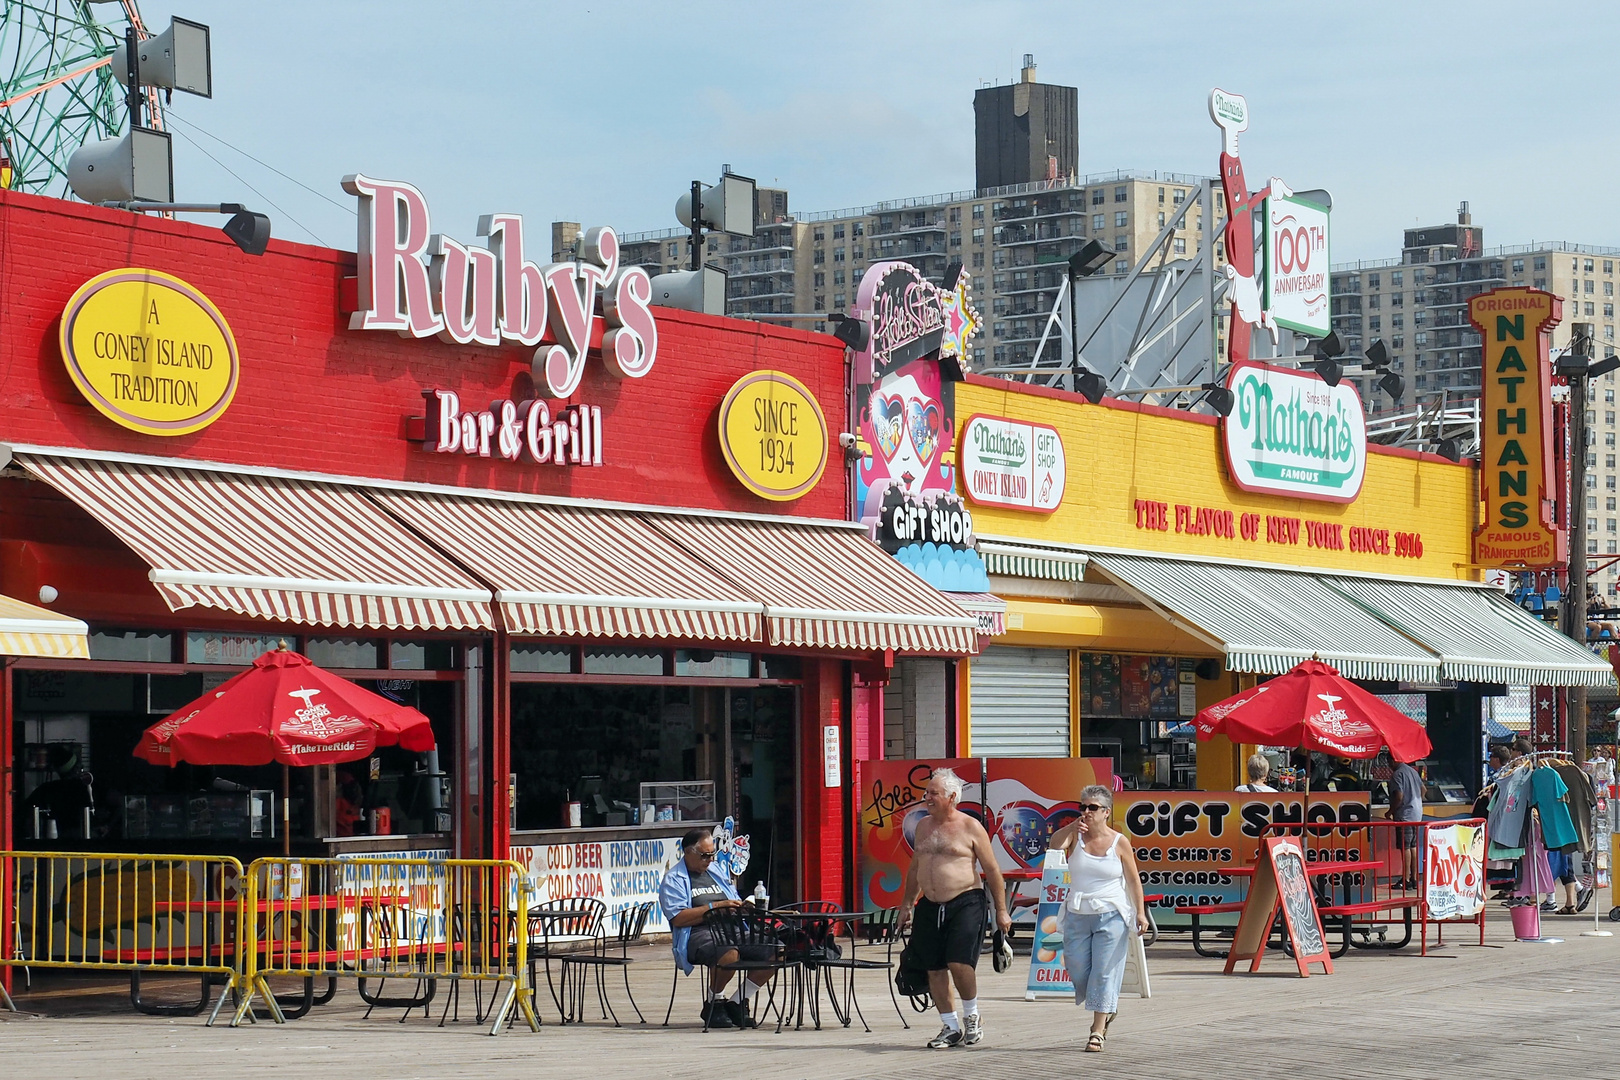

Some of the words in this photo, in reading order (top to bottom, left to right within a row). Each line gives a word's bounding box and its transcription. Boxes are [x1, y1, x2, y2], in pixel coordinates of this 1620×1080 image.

[1274, 225, 1325, 275] 100TH
[337, 173, 658, 399] Ruby's
[1274, 272, 1325, 297] ANNIVERSARY
[147, 298, 160, 325] A
[1476, 297, 1545, 312] ORIGINAL
[93, 331, 150, 363] CONEY
[156, 338, 213, 370] ISLAND
[110, 372, 199, 408] TRADITION
[1306, 391, 1320, 405] Since
[1320, 395, 1331, 407] 1916
[425, 388, 495, 454] Bar
[526, 399, 604, 467] Grill
[753, 397, 798, 437] SINCE
[1237, 374, 1353, 463] Nathan's
[1495, 314, 1529, 529] NATHANS
[973, 422, 1027, 458] Nathan's
[1037, 433, 1055, 453] GIFT
[758, 437, 795, 475] 1934
[1037, 453, 1056, 469] SHOP
[972, 469, 999, 496] CONEY
[1000, 473, 1027, 500] ISLAND
[1280, 467, 1319, 483] FAMOUS
[930, 508, 973, 544] SHOP
[1134, 498, 1169, 532] THE
[1174, 504, 1236, 539] FLAVOR
[1240, 512, 1260, 541] OF
[1266, 515, 1301, 545] NEW
[1305, 519, 1344, 550] YORK
[1349, 525, 1391, 555] SINCE
[1394, 531, 1424, 558] 1916
[1487, 532, 1542, 543] FAMOUS
[1478, 540, 1551, 561] FRANKFURTERS
[974, 616, 994, 629] .COM
[1240, 800, 1370, 838] SHOP
[547, 845, 573, 870] COLD
[575, 843, 604, 869] BEER
[610, 841, 633, 868] FRIED
[634, 840, 664, 867] SHRIMP
[1428, 843, 1476, 894] Ruby's
[547, 873, 573, 900] COLD
[575, 872, 605, 899] SODA
[1139, 870, 1233, 887] OSTCARDS
[1036, 968, 1073, 983] CLAM
